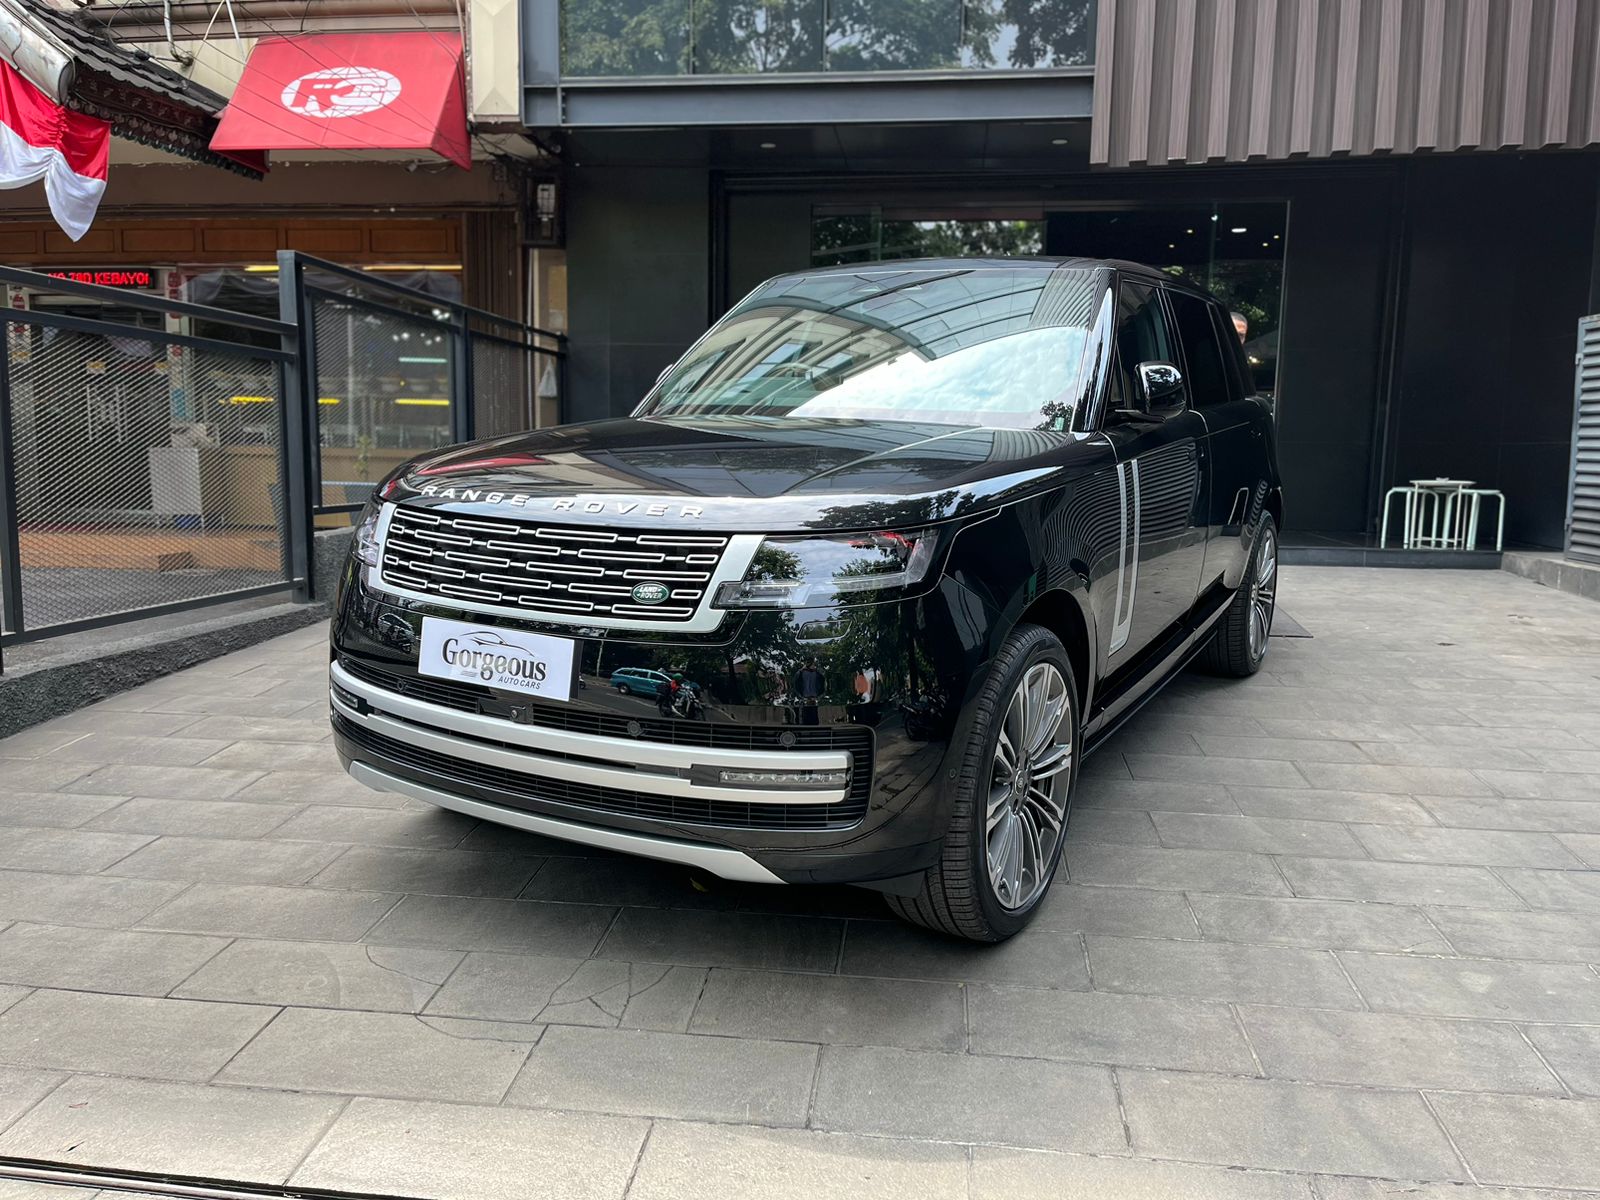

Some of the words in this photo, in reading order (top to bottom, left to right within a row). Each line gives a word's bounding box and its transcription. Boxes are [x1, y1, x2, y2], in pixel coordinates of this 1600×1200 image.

[421, 485, 530, 507] RANGE
[552, 498, 703, 519] ROVER
[442, 637, 547, 681] Gorgeous
